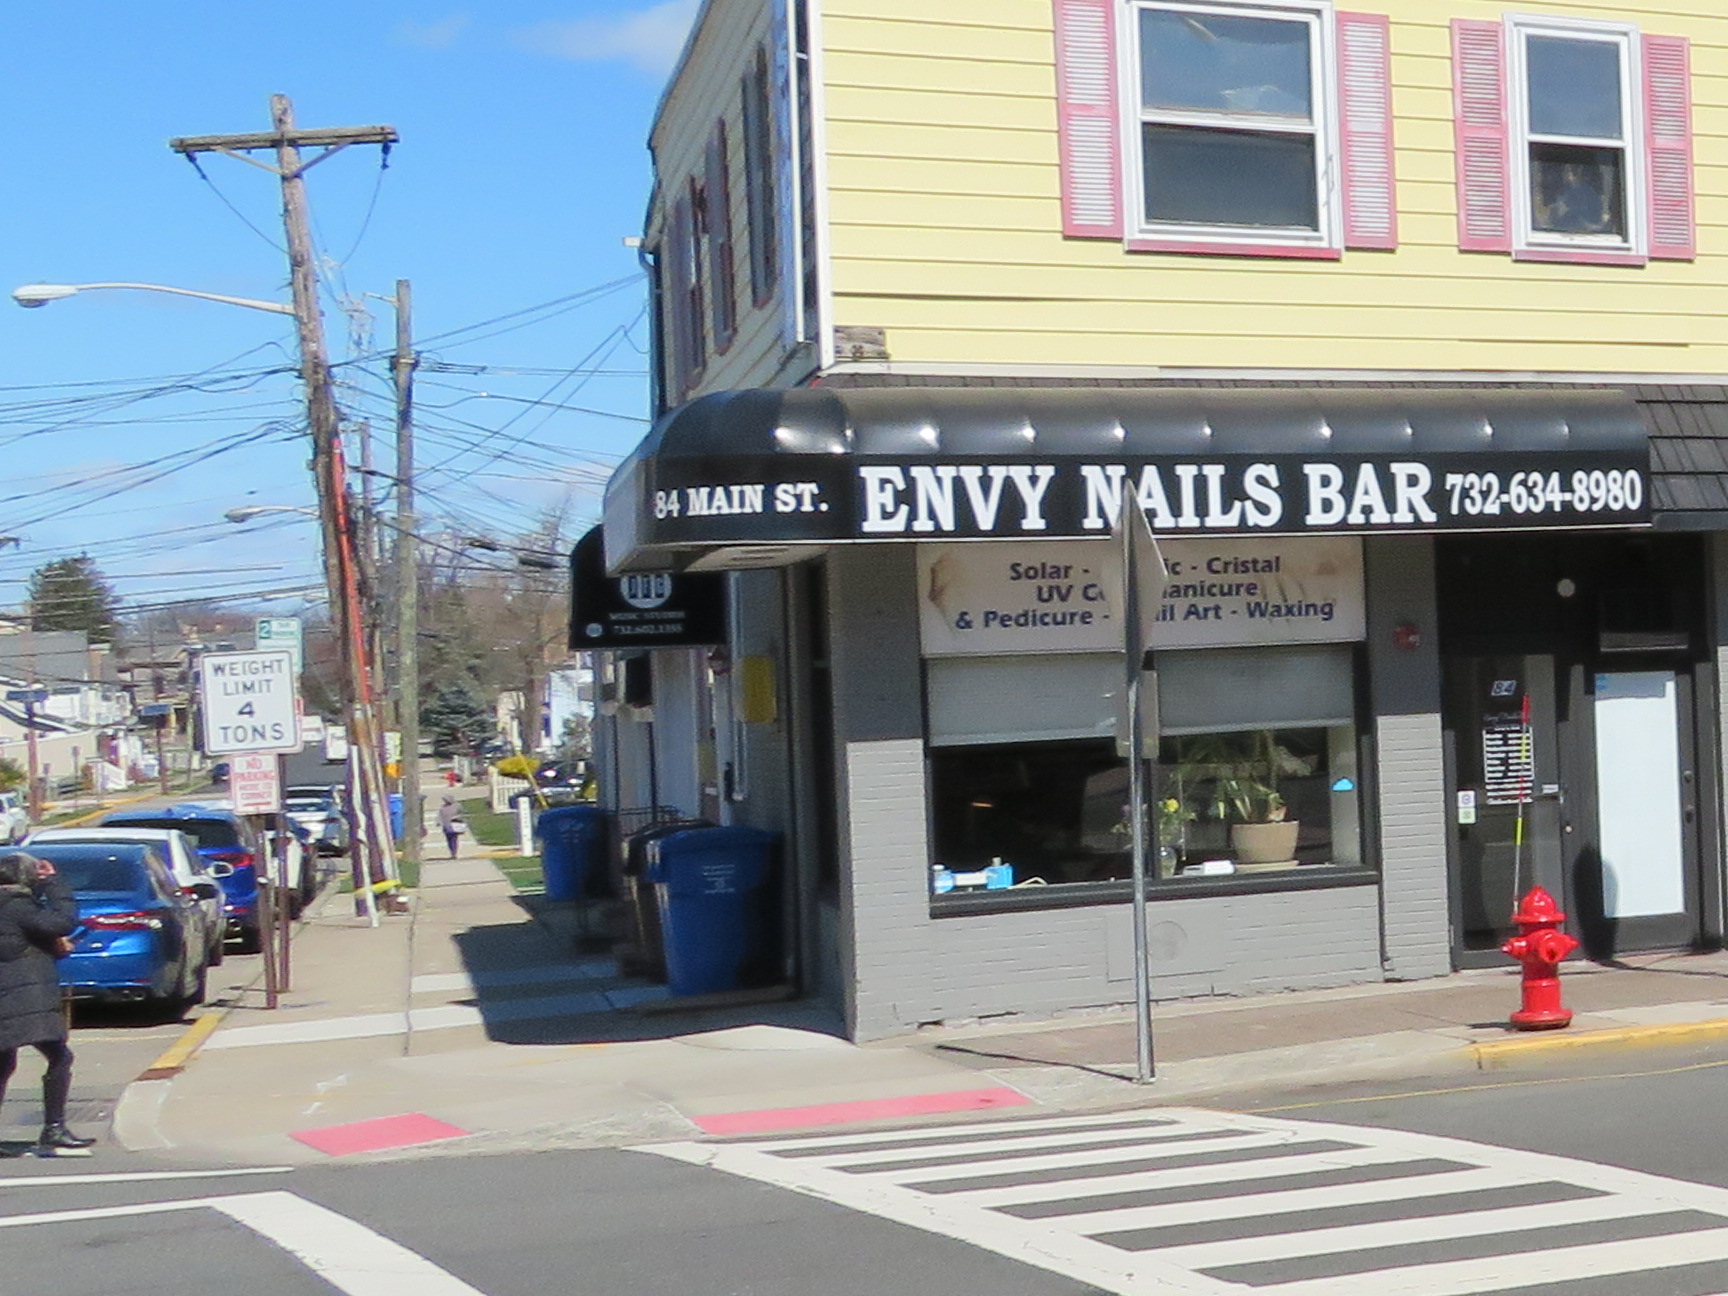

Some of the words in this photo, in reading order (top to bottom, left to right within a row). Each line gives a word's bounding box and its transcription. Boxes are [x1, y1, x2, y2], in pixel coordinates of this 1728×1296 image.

[654, 489, 680, 519] 84
[686, 483, 764, 516] MAIN
[775, 481, 829, 512] ST.
[858, 464, 1055, 532] ENVY
[1080, 462, 1283, 530] NAILS
[1303, 462, 1436, 526] BAR
[1444, 468, 1643, 515] 732-634-8980
[1009, 562, 1071, 581] Solar
[1206, 555, 1281, 575] Cristal
[1037, 585, 1071, 603] UV
[1162, 580, 1258, 601] anicure
[955, 612, 974, 630] &
[983, 606, 1094, 629] Pedicure
[1183, 602, 1223, 621] Art
[1246, 597, 1335, 623] Waxing
[212, 659, 285, 677] WEIGHT
[223, 679, 274, 697] LIMIT
[1493, 681, 1515, 695] 84
[237, 701, 256, 718] 4
[218, 722, 284, 744] TONS
[245, 758, 263, 770] NO
[233, 770, 276, 783] PARKING
